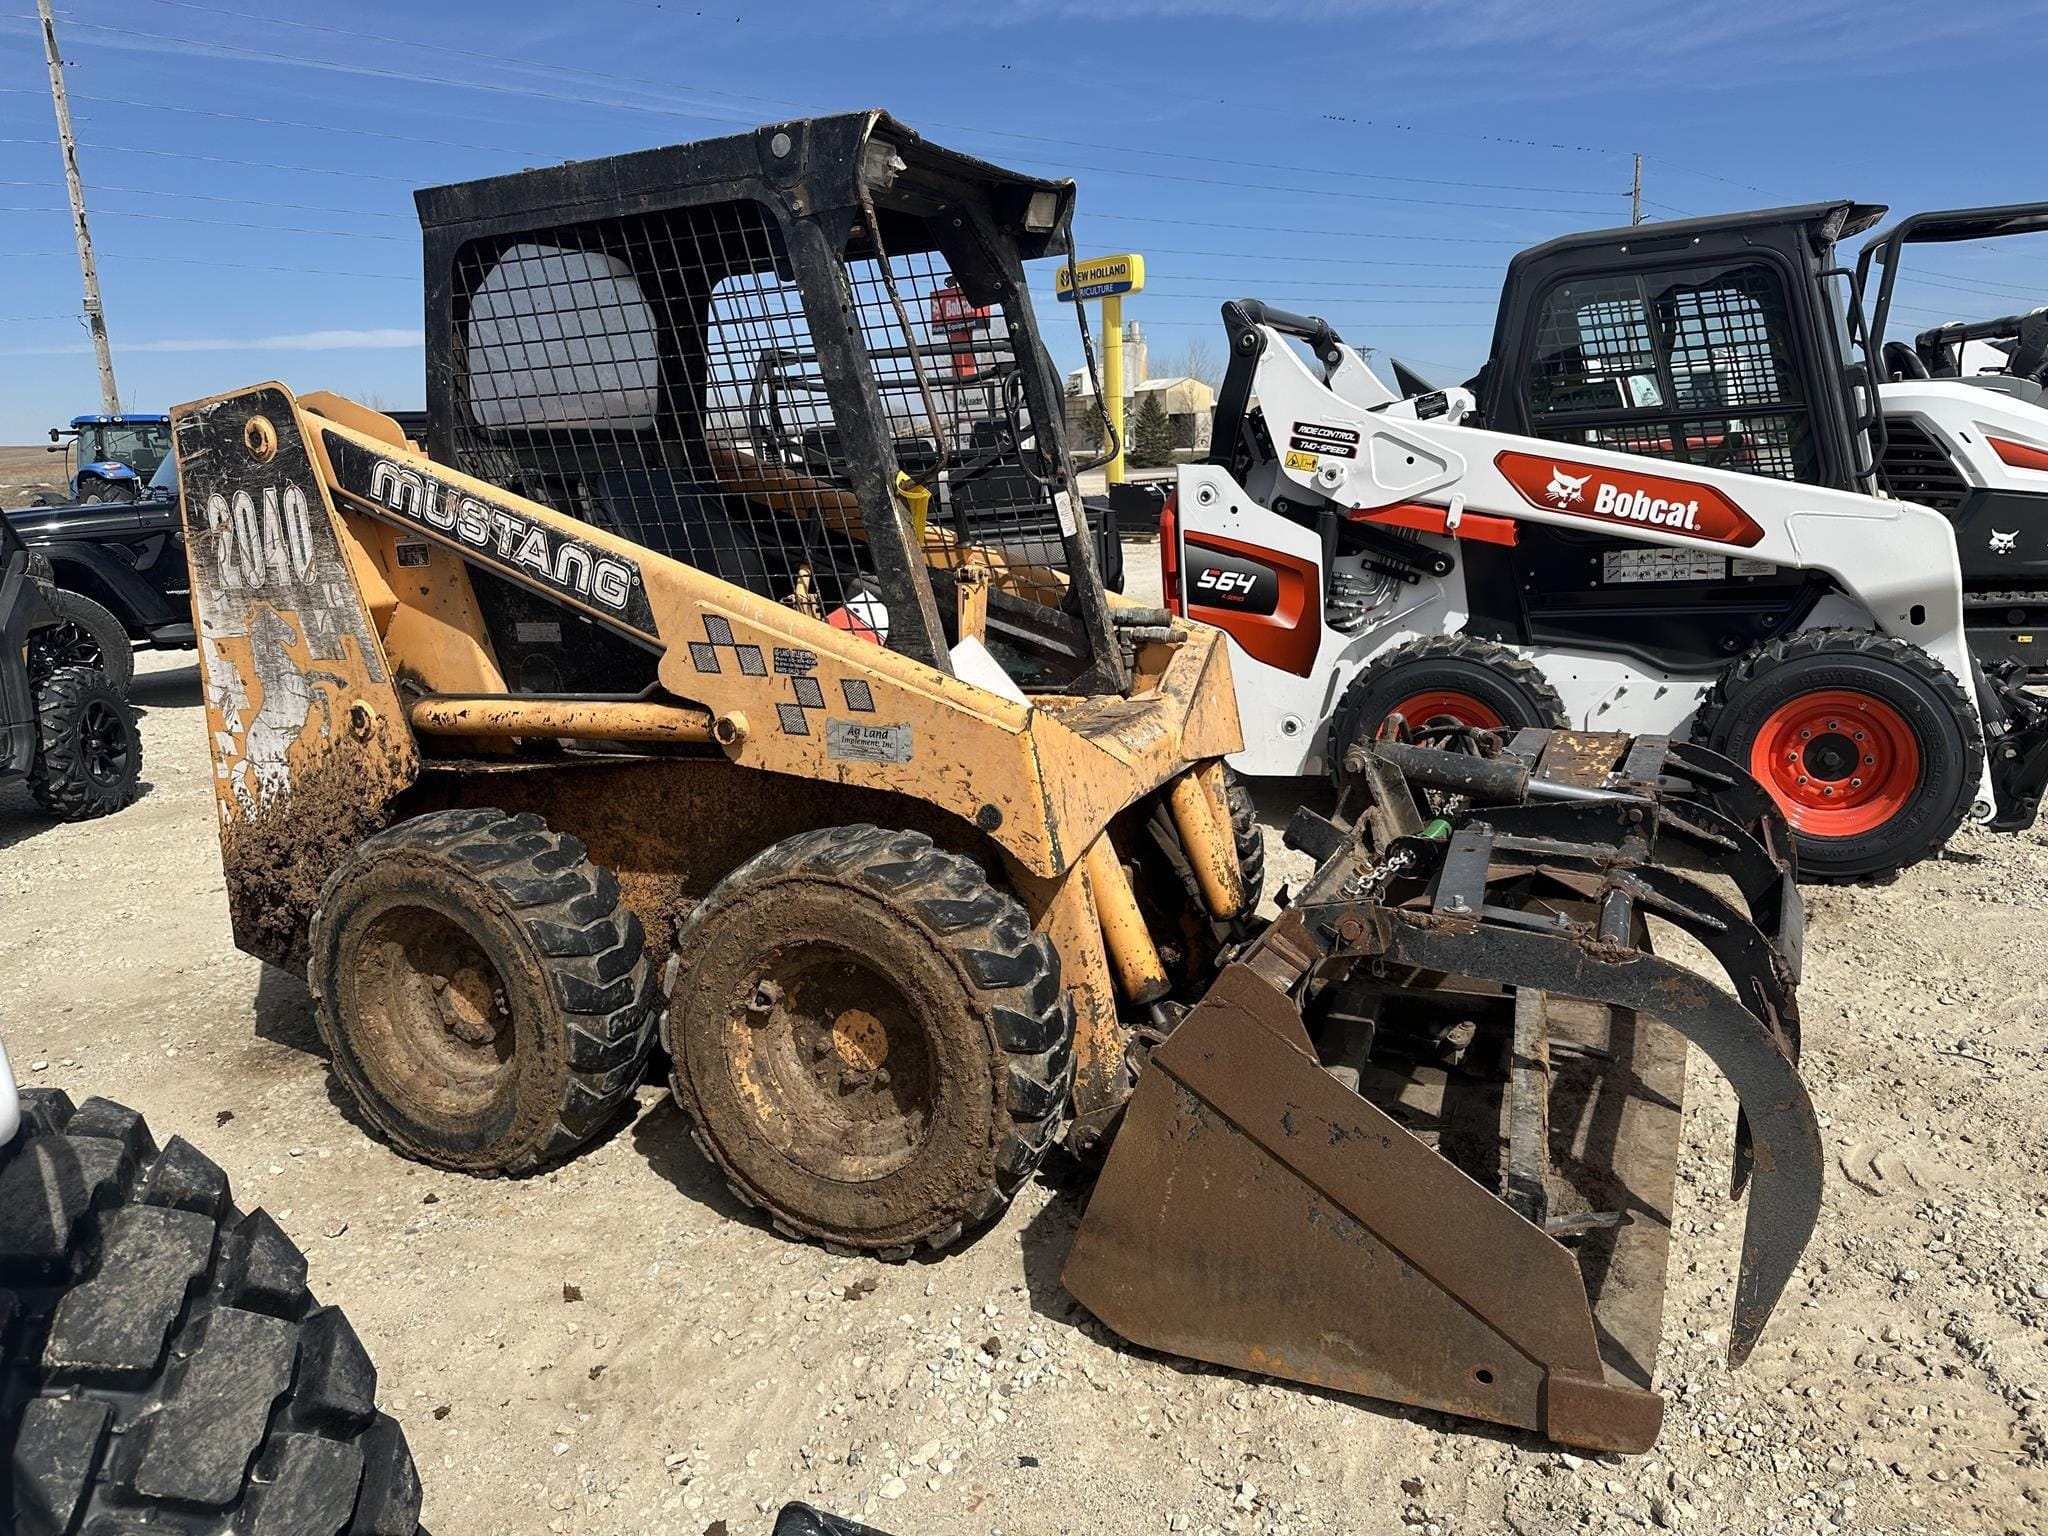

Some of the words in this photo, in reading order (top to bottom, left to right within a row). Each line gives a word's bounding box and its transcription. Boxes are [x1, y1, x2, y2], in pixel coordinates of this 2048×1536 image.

[1077, 270, 1088, 281] EW
[1090, 263, 1126, 280] HOLLAND
[945, 297, 976, 317] Bobca
[1298, 425, 1319, 435] RIDE
[1318, 427, 1356, 441] CONTROL
[1300, 440, 1349, 455] TWO-SPEED
[1593, 483, 1700, 530] Bobcat
[207, 478, 318, 590] 2040
[369, 458, 632, 611] MUSTANG
[1196, 568, 1257, 594] S64
[847, 726, 860, 740] Ag
[864, 728, 889, 740] Land
